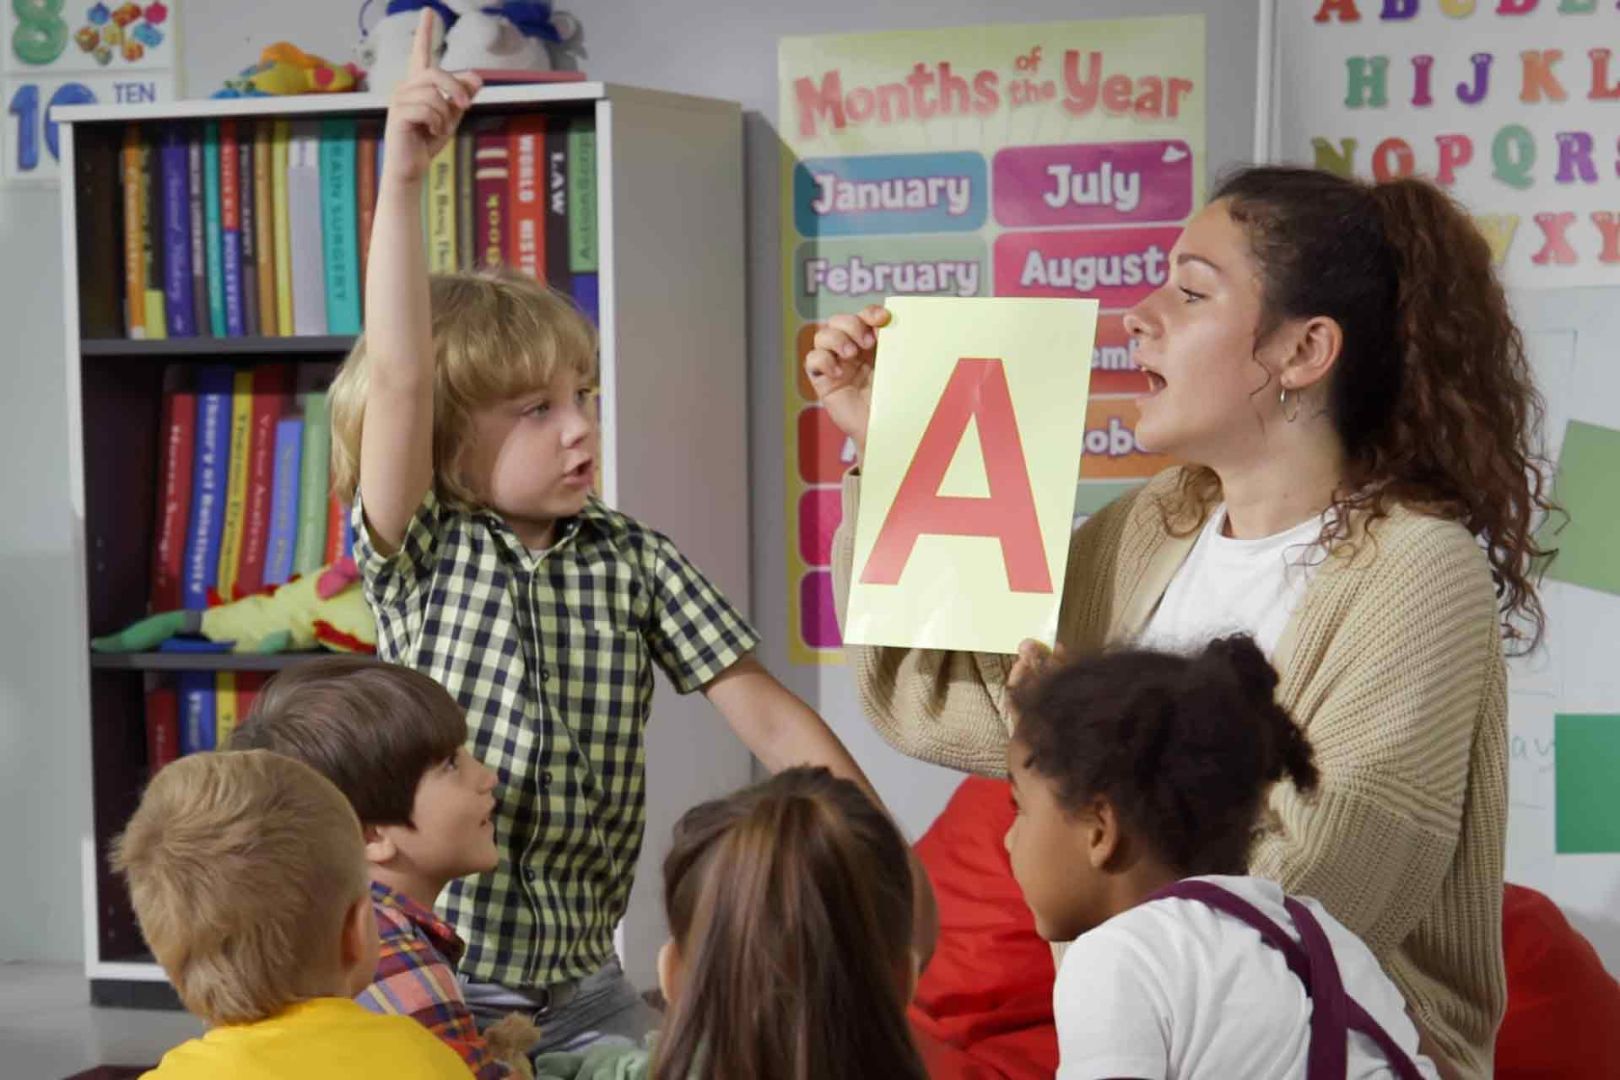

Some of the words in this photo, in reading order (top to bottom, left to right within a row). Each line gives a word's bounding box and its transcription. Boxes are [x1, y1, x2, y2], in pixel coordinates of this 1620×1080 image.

[12, 0, 68, 65] 8
[1014, 46, 1042, 73] of
[113, 81, 157, 104] TEN
[793, 62, 1000, 139] Months
[1009, 75, 1057, 103] the
[1063, 49, 1194, 118] Year
[1344, 55, 1389, 109] H
[1456, 53, 1493, 105] J
[1518, 49, 1568, 104] K
[518, 134, 534, 203] WORLD
[551, 152, 565, 216] LAW
[1491, 124, 1537, 190] Q
[1554, 131, 1599, 183] R
[812, 172, 972, 215] January
[1043, 160, 1142, 212] July
[1531, 211, 1579, 265] X
[803, 255, 981, 298] February
[1020, 245, 1166, 292] August
[859, 358, 1054, 594] A
